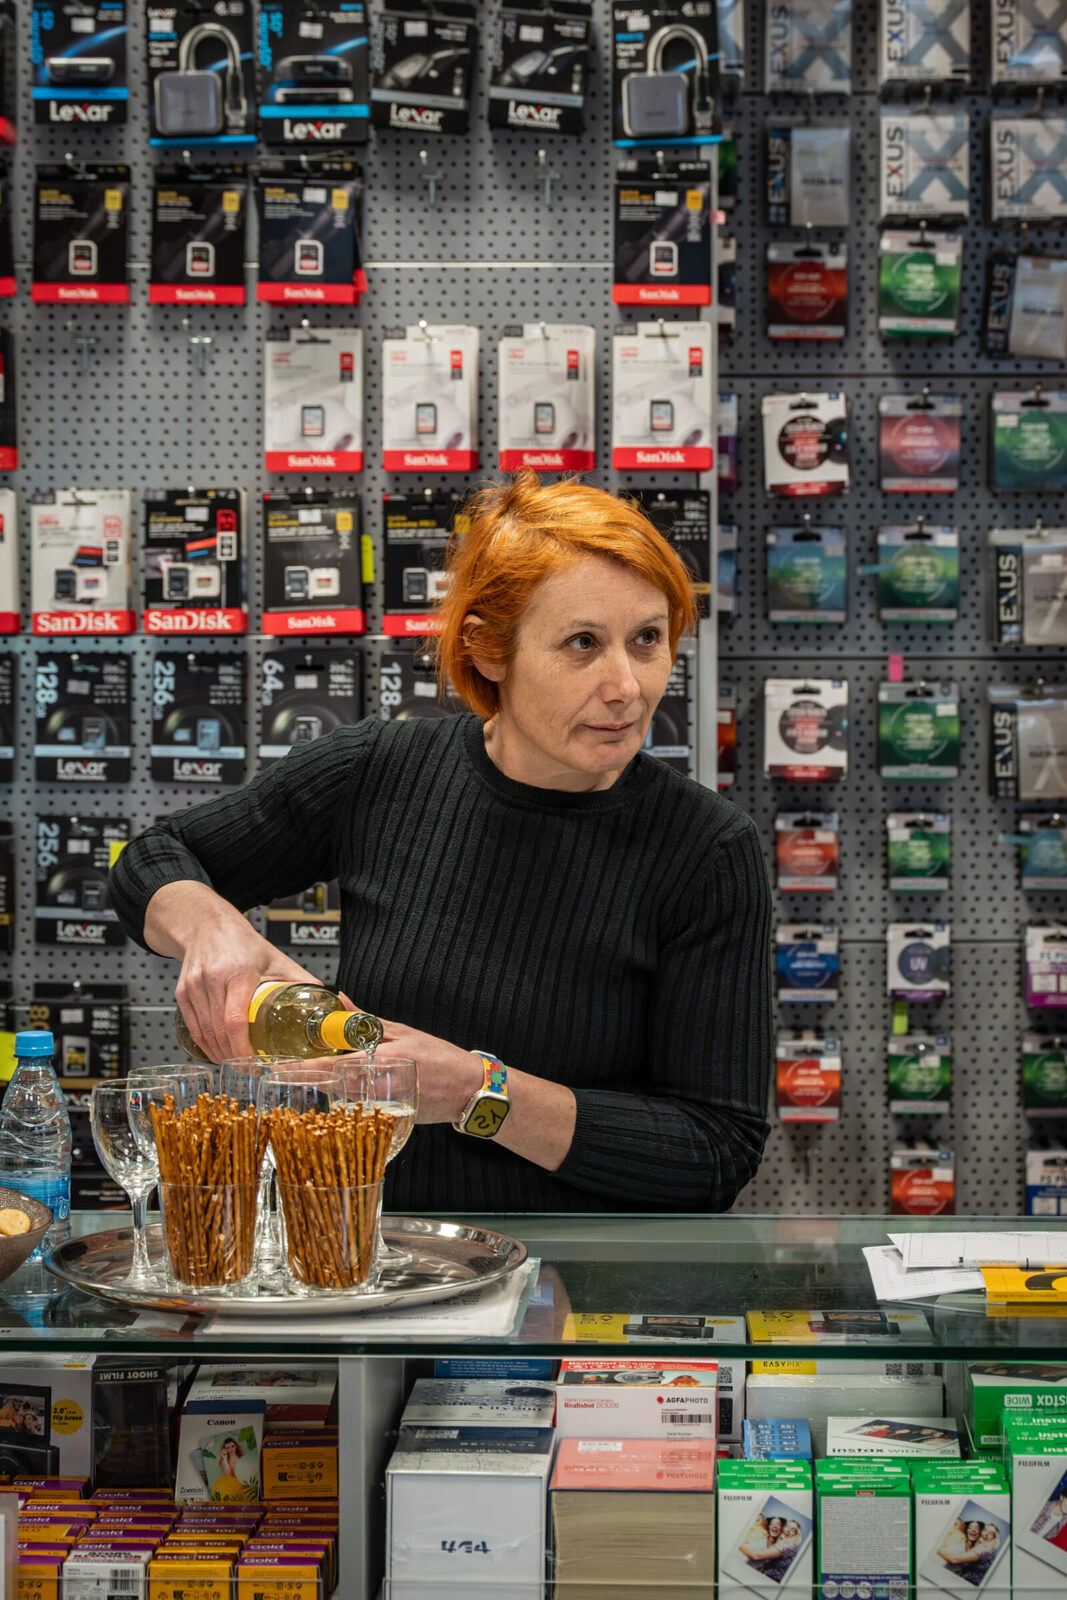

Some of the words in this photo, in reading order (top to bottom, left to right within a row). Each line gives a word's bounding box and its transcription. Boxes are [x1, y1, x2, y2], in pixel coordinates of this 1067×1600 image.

[770, 5, 789, 75] EXUS
[49, 101, 113, 123] Lexar
[390, 102, 444, 124] Lexar
[508, 100, 562, 122] Lexar
[283, 119, 347, 141] Lexar
[887, 126, 905, 199] EXUS
[996, 129, 1015, 202] EXUS
[58, 287, 98, 300] SanDisk
[175, 288, 216, 301] SanDisk
[284, 287, 325, 300] SanDisk
[639, 289, 680, 301] SanDisk
[989, 263, 1012, 330] EXUS
[287, 454, 337, 468] SanDisk
[404, 453, 448, 466] SanDisk
[523, 453, 564, 466] SanDisk
[636, 450, 686, 464] SanDisk
[999, 553, 1019, 622] EXUS
[37, 611, 121, 632] SanDisk
[148, 610, 233, 631] SanDisk
[287, 615, 337, 630] SanDisk
[262, 658, 285, 691] 64
[35, 660, 59, 705] 128
[154, 660, 176, 706] 256
[380, 661, 403, 706] 128
[993, 710, 1014, 780] EXUS
[56, 758, 108, 777] Lexar
[173, 758, 224, 777] Lexar
[37, 821, 60, 868] 256
[56, 919, 108, 939] Lexar
[291, 921, 340, 940] Lexar
[909, 956, 929, 972] UV
[763, 1360, 801, 1368] EASYPIX
[99, 1371, 125, 1381] FILM!
[126, 1370, 159, 1380] SHOOT
[666, 1396, 710, 1404] AGFAPHOTO
[1005, 1395, 1031, 1406] WIDE
[207, 1418, 236, 1427] Canon
[832, 1447, 885, 1455] instax
[14, 1480, 46, 1488] Gold
[100, 1516, 134, 1524] Gold
[90, 1529, 124, 1537] Gold
[260, 1530, 295, 1538] Gold
[78, 1542, 113, 1551] Gold
[250, 1543, 285, 1552] Gold
[244, 1556, 279, 1565] Gold
